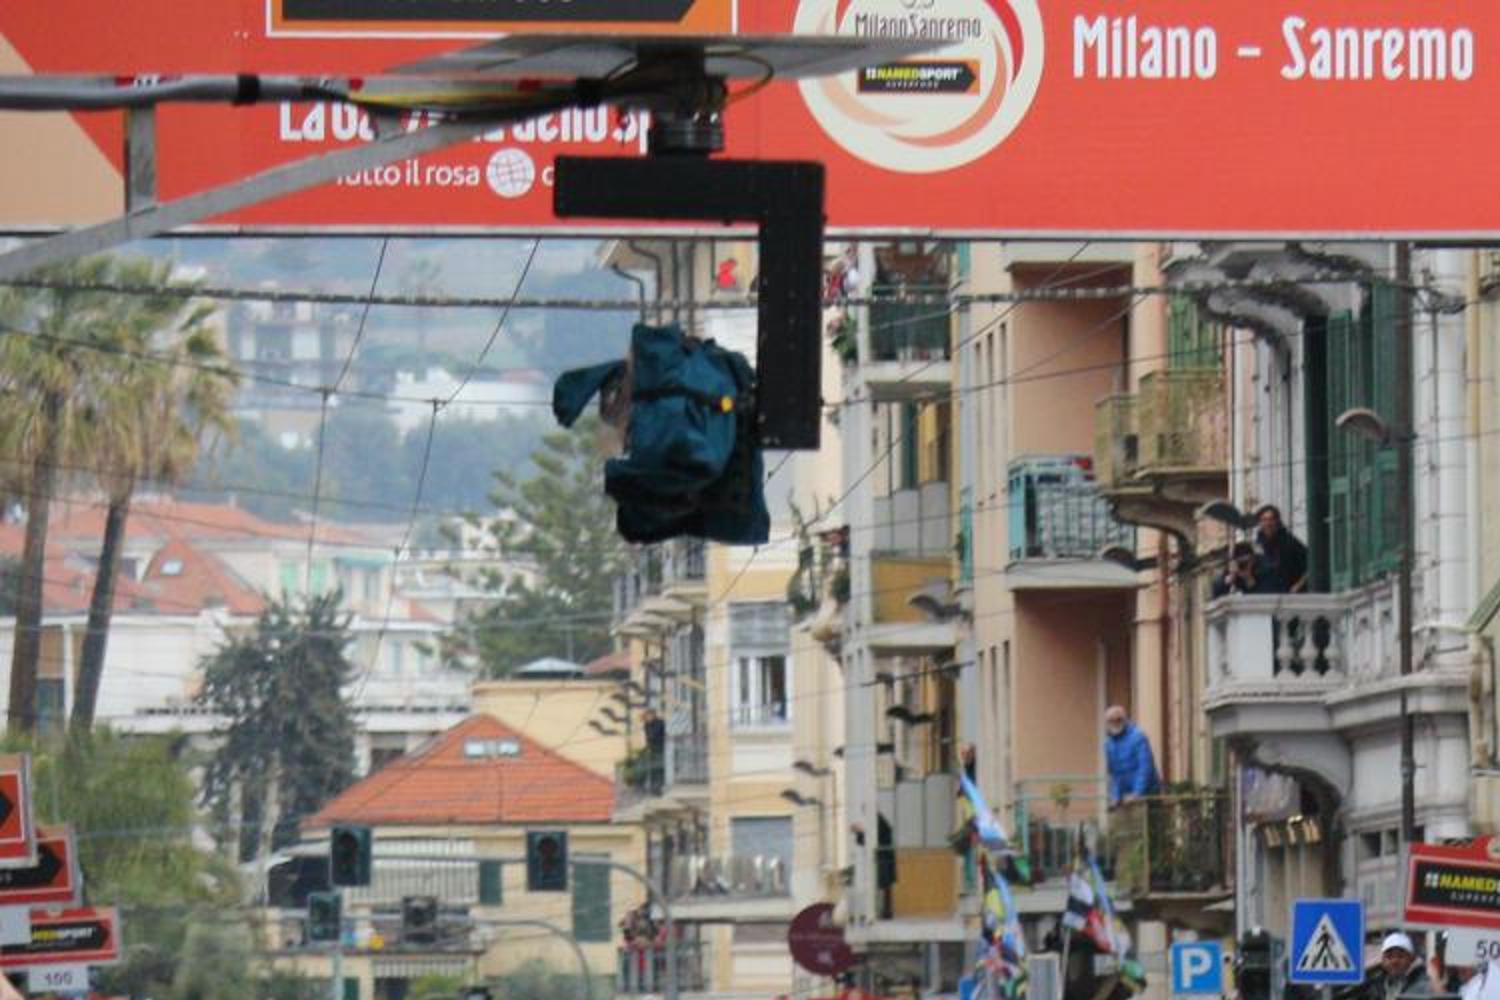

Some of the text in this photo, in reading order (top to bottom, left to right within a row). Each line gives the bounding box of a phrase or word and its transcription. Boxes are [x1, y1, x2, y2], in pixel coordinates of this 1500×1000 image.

[1073, 15, 1217, 79] Milano
[1280, 15, 1474, 81] Sanremo
[405, 160, 421, 186] il
[425, 163, 480, 186] rosa
[1180, 947, 1213, 989] P
